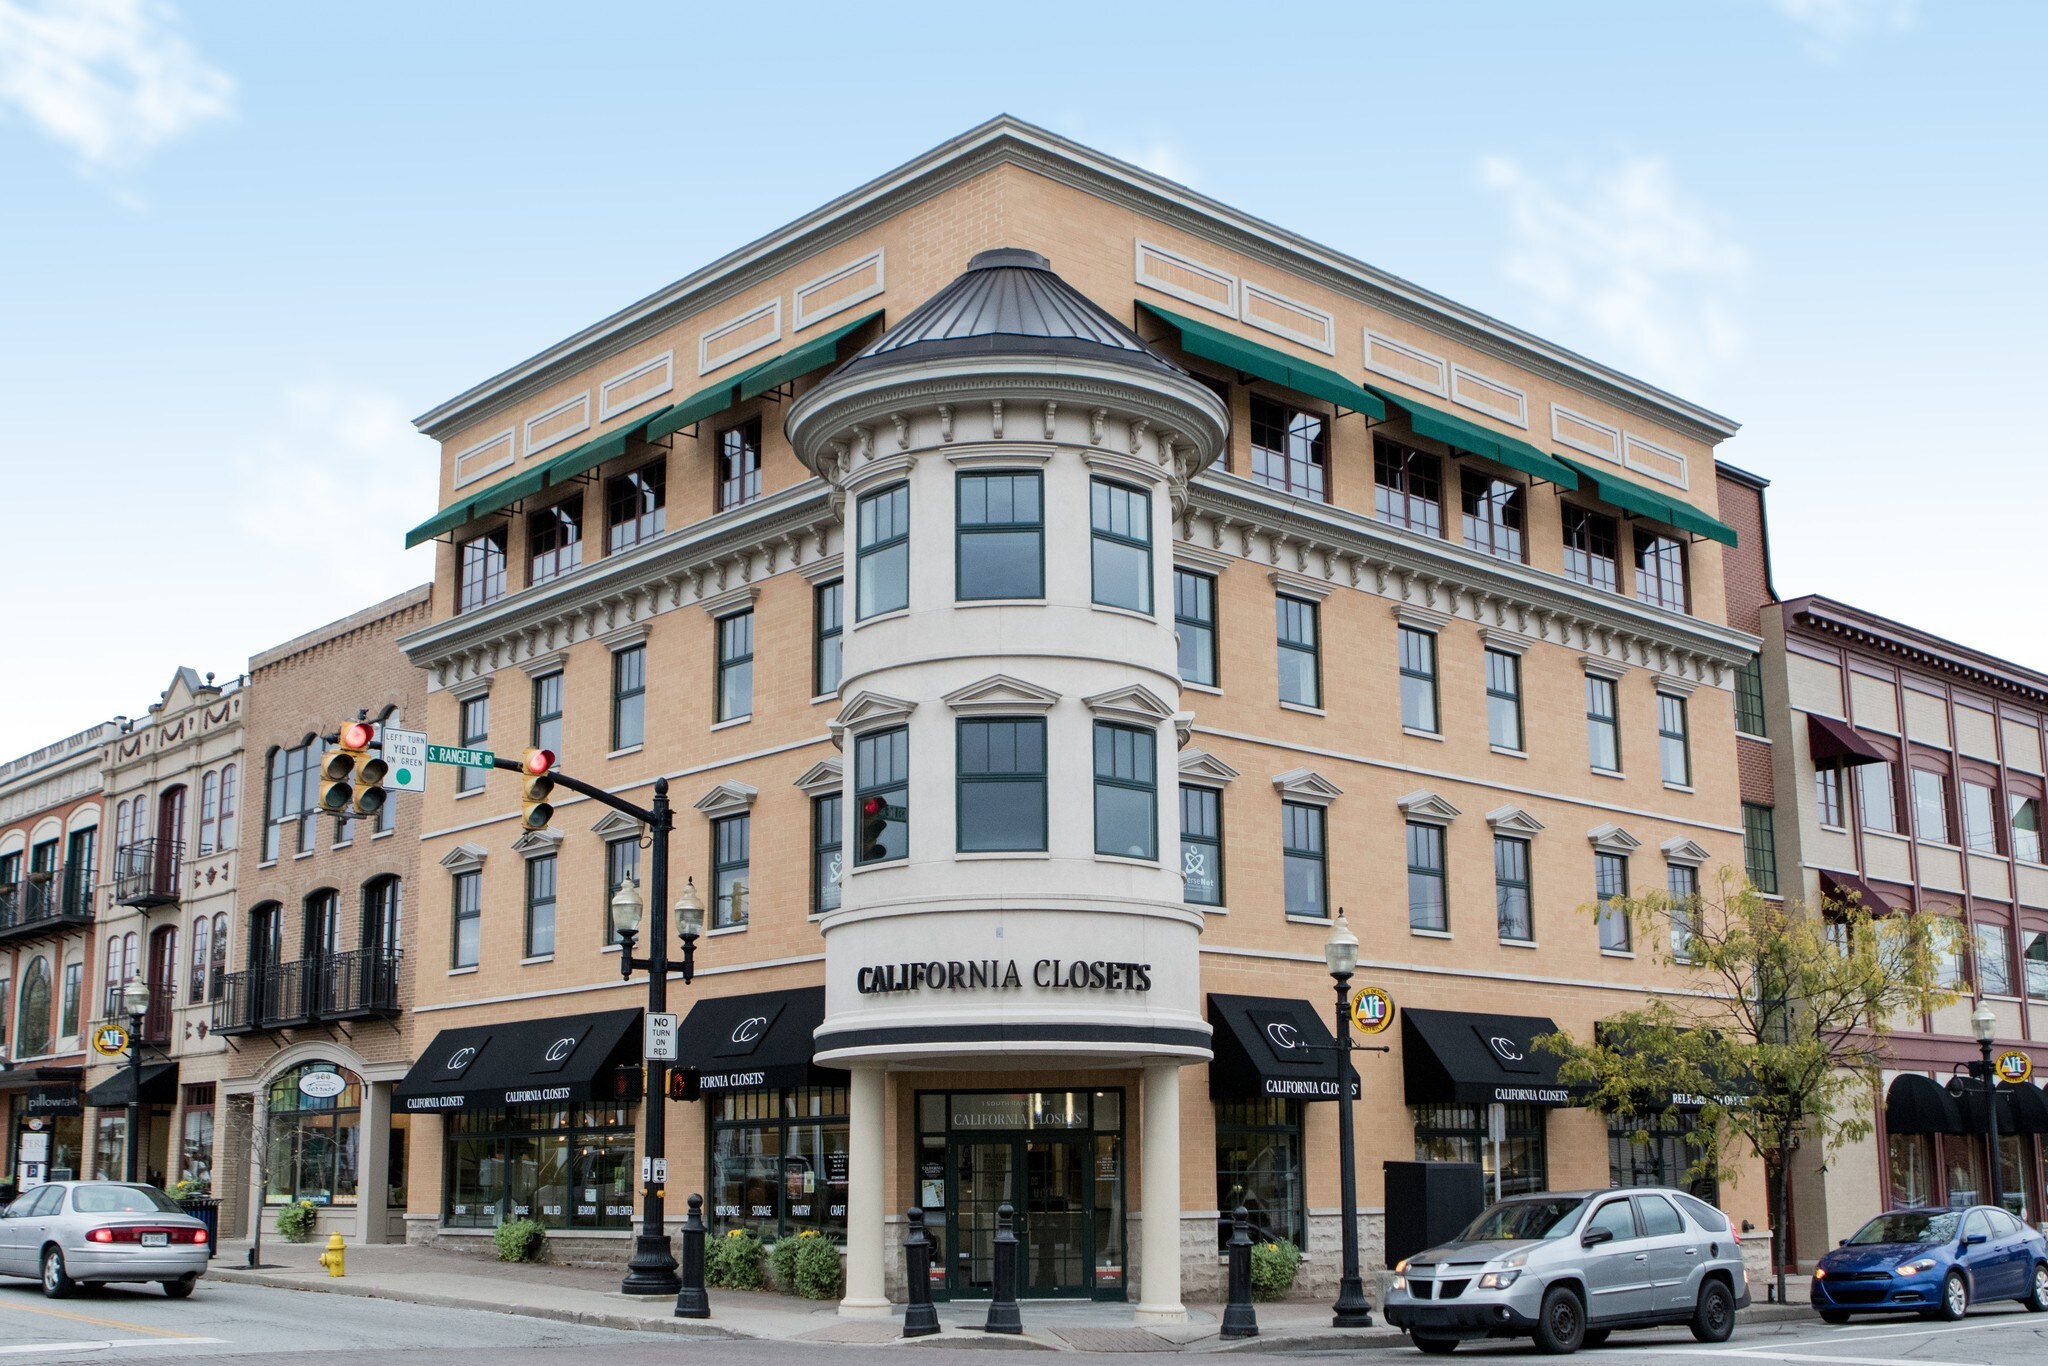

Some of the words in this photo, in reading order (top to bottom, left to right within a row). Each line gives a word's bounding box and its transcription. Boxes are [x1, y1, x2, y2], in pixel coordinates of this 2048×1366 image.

[386, 733, 402, 741] LEFT
[407, 735, 425, 744] TURN
[394, 744, 417, 756] YIELD
[401, 758, 423, 766] GREEN
[440, 748, 483, 766] RANGELINE
[484, 756, 493, 765] RD
[857, 960, 1023, 994] CALIFORNIA
[1033, 959, 1152, 992] CLOSETS
[654, 1018, 669, 1027] NO
[652, 1029, 671, 1037] TURN
[653, 1048, 668, 1056] RED
[700, 1074, 729, 1089] FORNIA
[730, 1072, 763, 1086] CLOSETS
[1266, 1080, 1319, 1094] CALIFORNIA
[505, 1089, 542, 1103] CALIFORNIA
[542, 1088, 570, 1100] CLOSETS
[1495, 1088, 1538, 1100] CALIFORNIA
[1538, 1089, 1567, 1101] CLOSETS
[29, 1094, 78, 1111] pillowtalk
[407, 1097, 439, 1109] CALIFORNIA
[440, 1096, 464, 1107] CLOSETS
[953, 1113, 1027, 1126] CALIFORNIA
[514, 1205, 529, 1215] GARAGE
[543, 1205, 553, 1215] WALL
[578, 1205, 596, 1215] BEDROOM
[606, 1205, 618, 1215] MEDIA
[619, 1205, 633, 1215] CENTER
[715, 1205, 726, 1216] KIDS
[727, 1205, 740, 1216] SPACE
[752, 1205, 772, 1216] STORAGE
[792, 1205, 811, 1216] PANTRY
[830, 1205, 846, 1216] CRAFT
